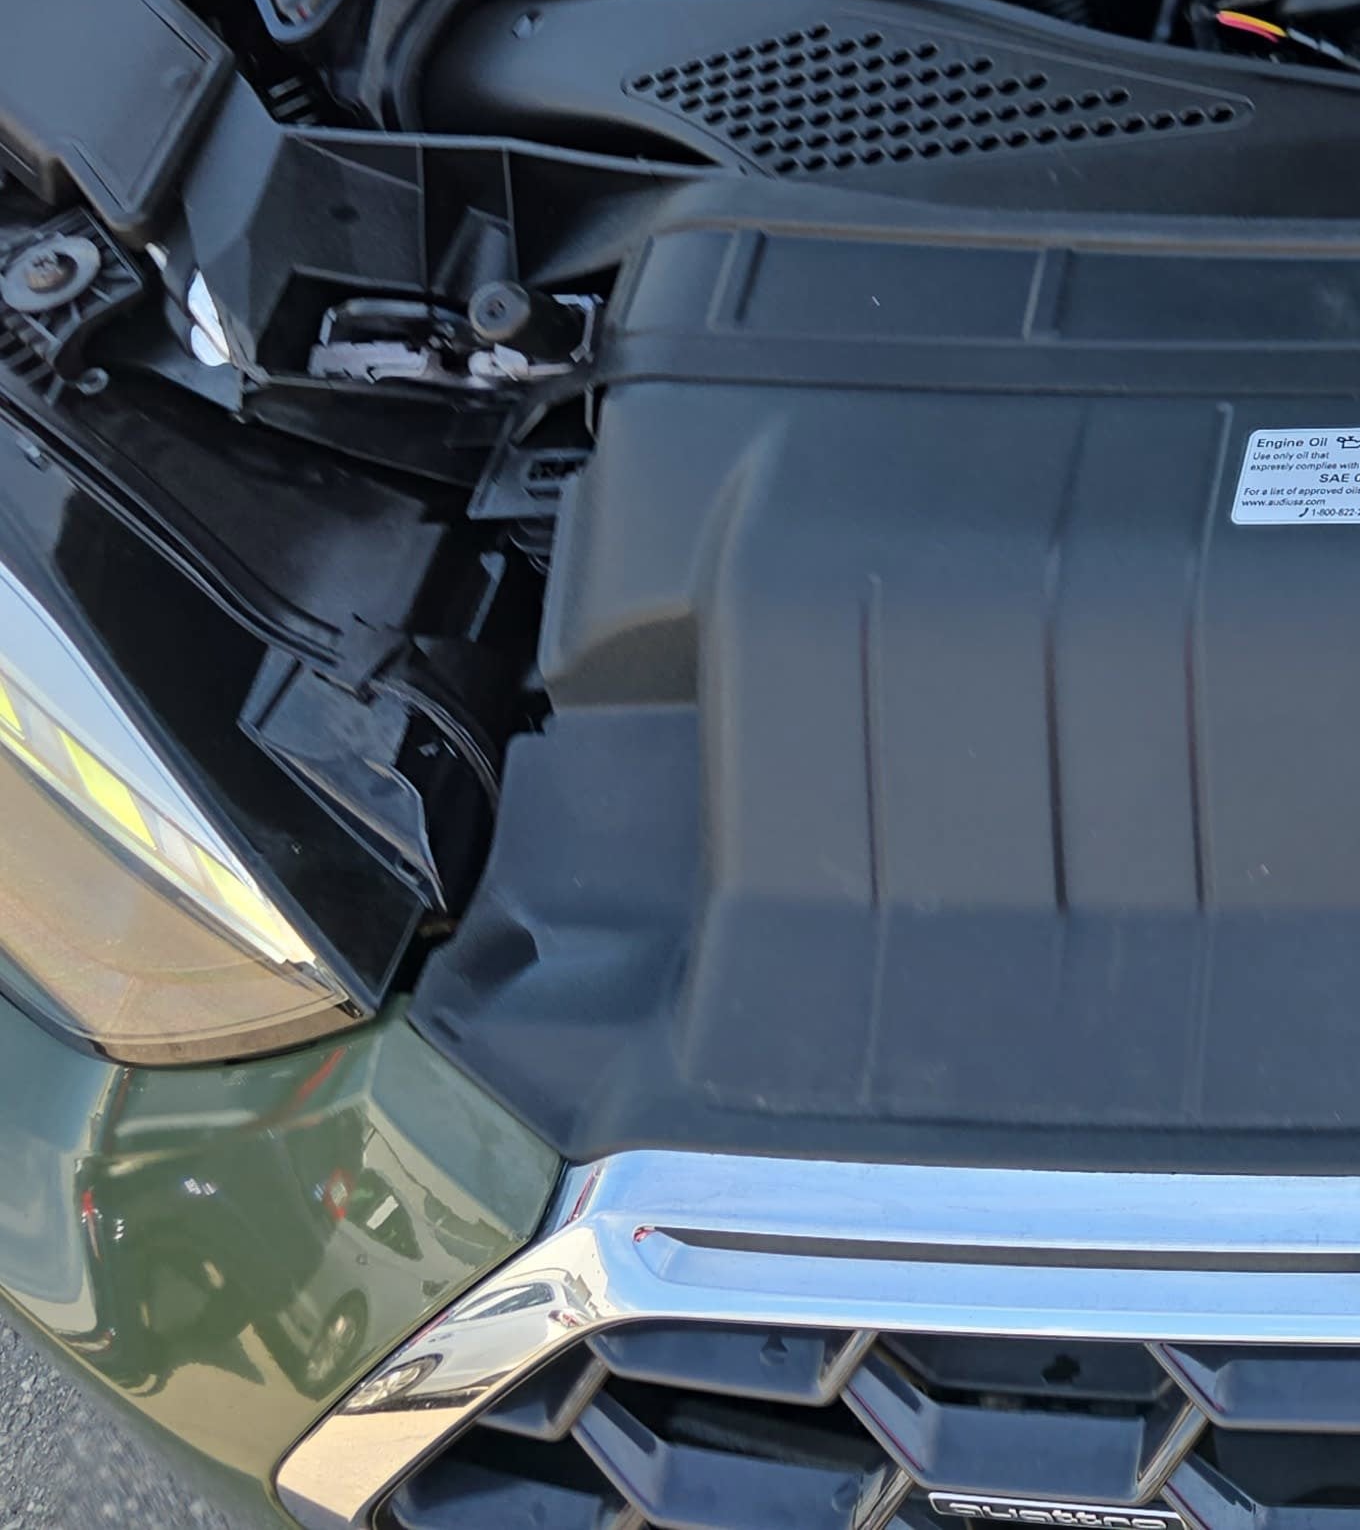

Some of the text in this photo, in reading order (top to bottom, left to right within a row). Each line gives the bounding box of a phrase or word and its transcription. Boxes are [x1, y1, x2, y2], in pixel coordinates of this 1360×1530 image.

[1257, 438, 1328, 449] Engine Oil
[1253, 451, 1329, 461] Use only oil that
[1250, 462, 1360, 472] expressly complies with
[1319, 473, 1350, 483] SAE
[1244, 488, 1260, 496] For
[1270, 487, 1284, 495] list
[1286, 487, 1297, 495] of
[1298, 486, 1344, 496] approved
[1242, 498, 1326, 507] www.audiusa.com
[949, 1502, 1167, 1529] quattro
